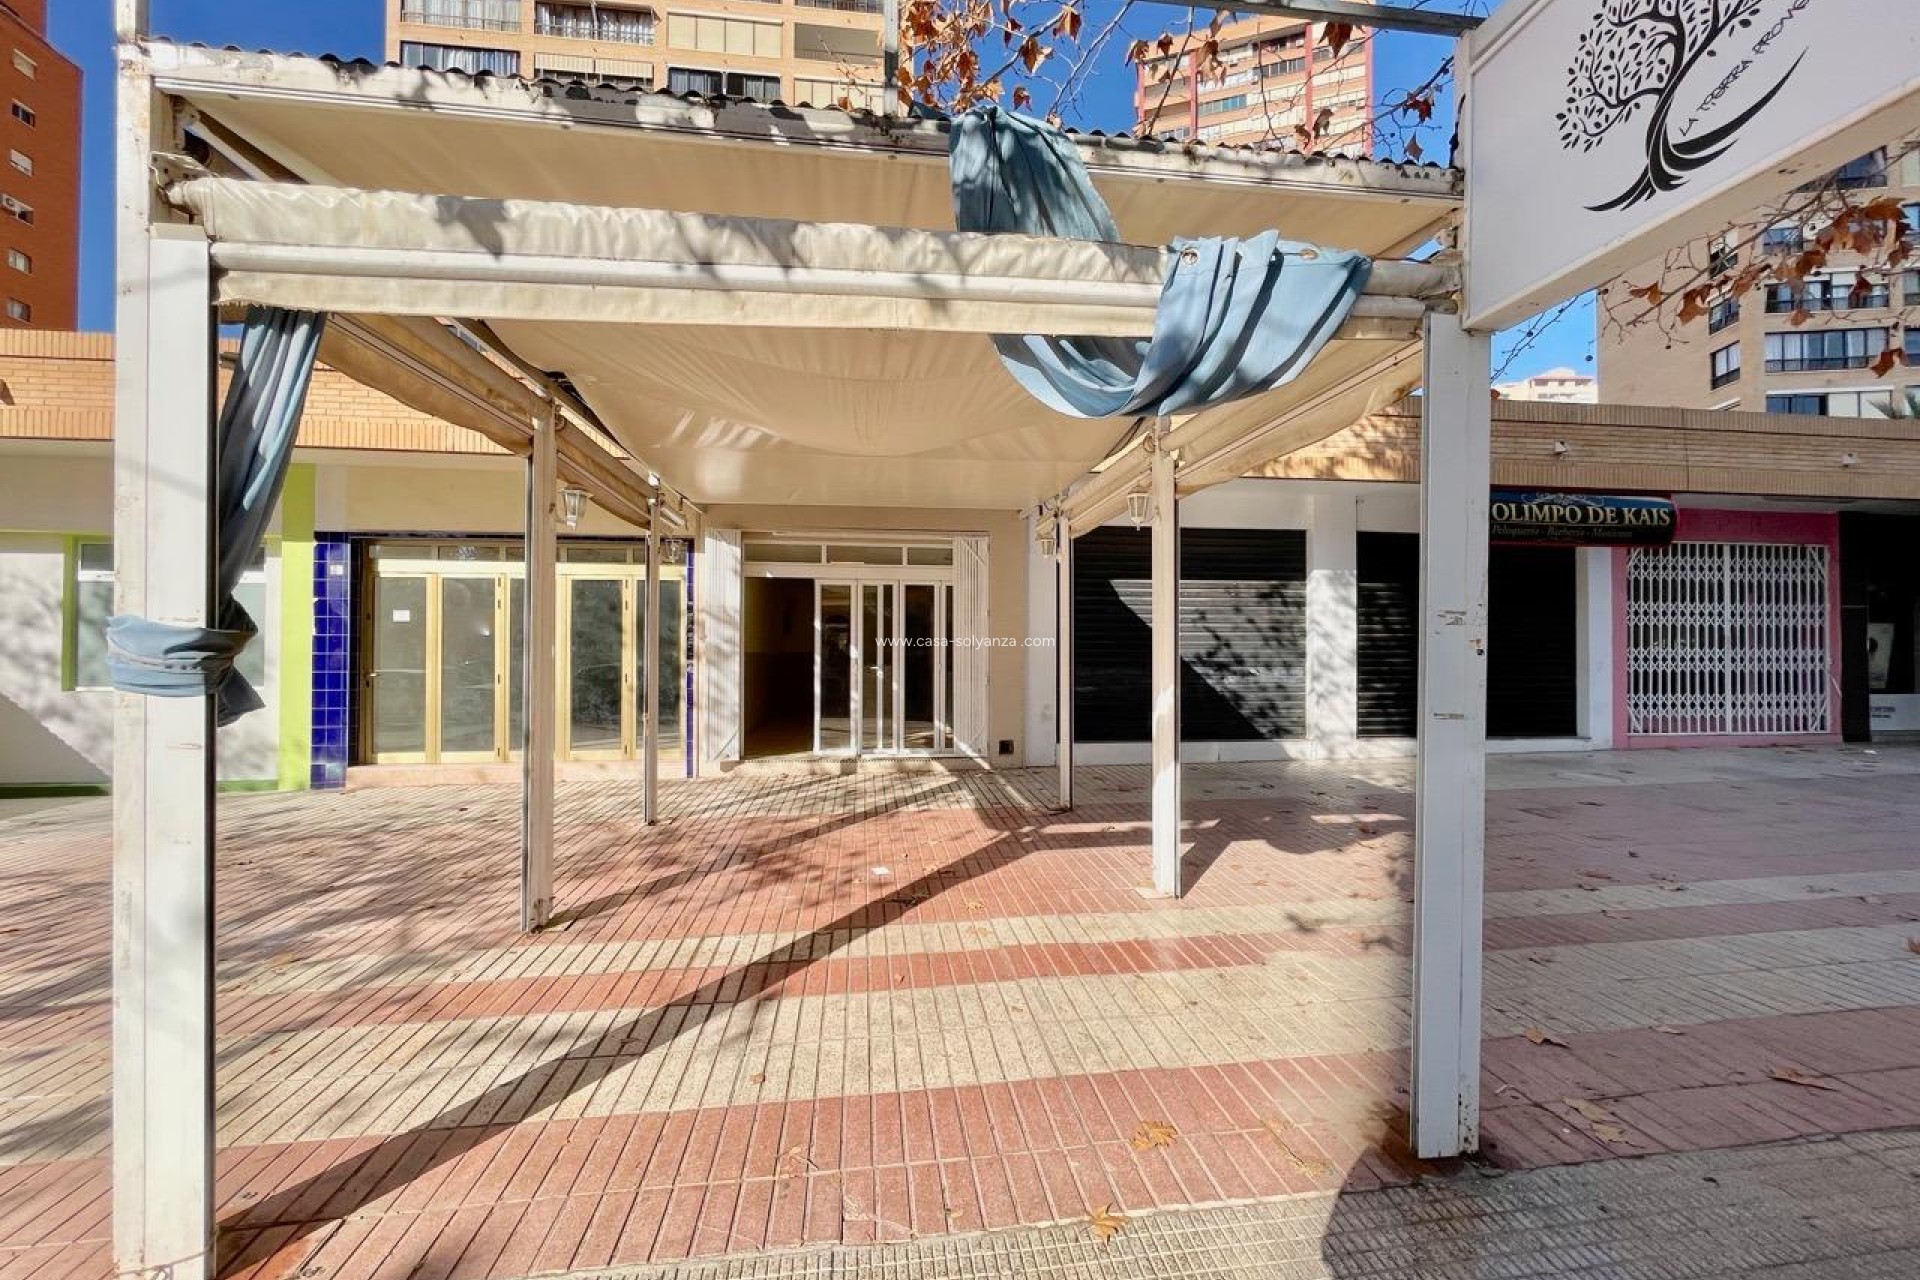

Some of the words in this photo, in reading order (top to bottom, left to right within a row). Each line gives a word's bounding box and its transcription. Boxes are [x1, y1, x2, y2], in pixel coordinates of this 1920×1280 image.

[1678, 117, 1699, 137] LA
[1491, 503, 1582, 524] OLIMPO
[1588, 506, 1619, 524] DE
[1624, 507, 1670, 526] KAIS
